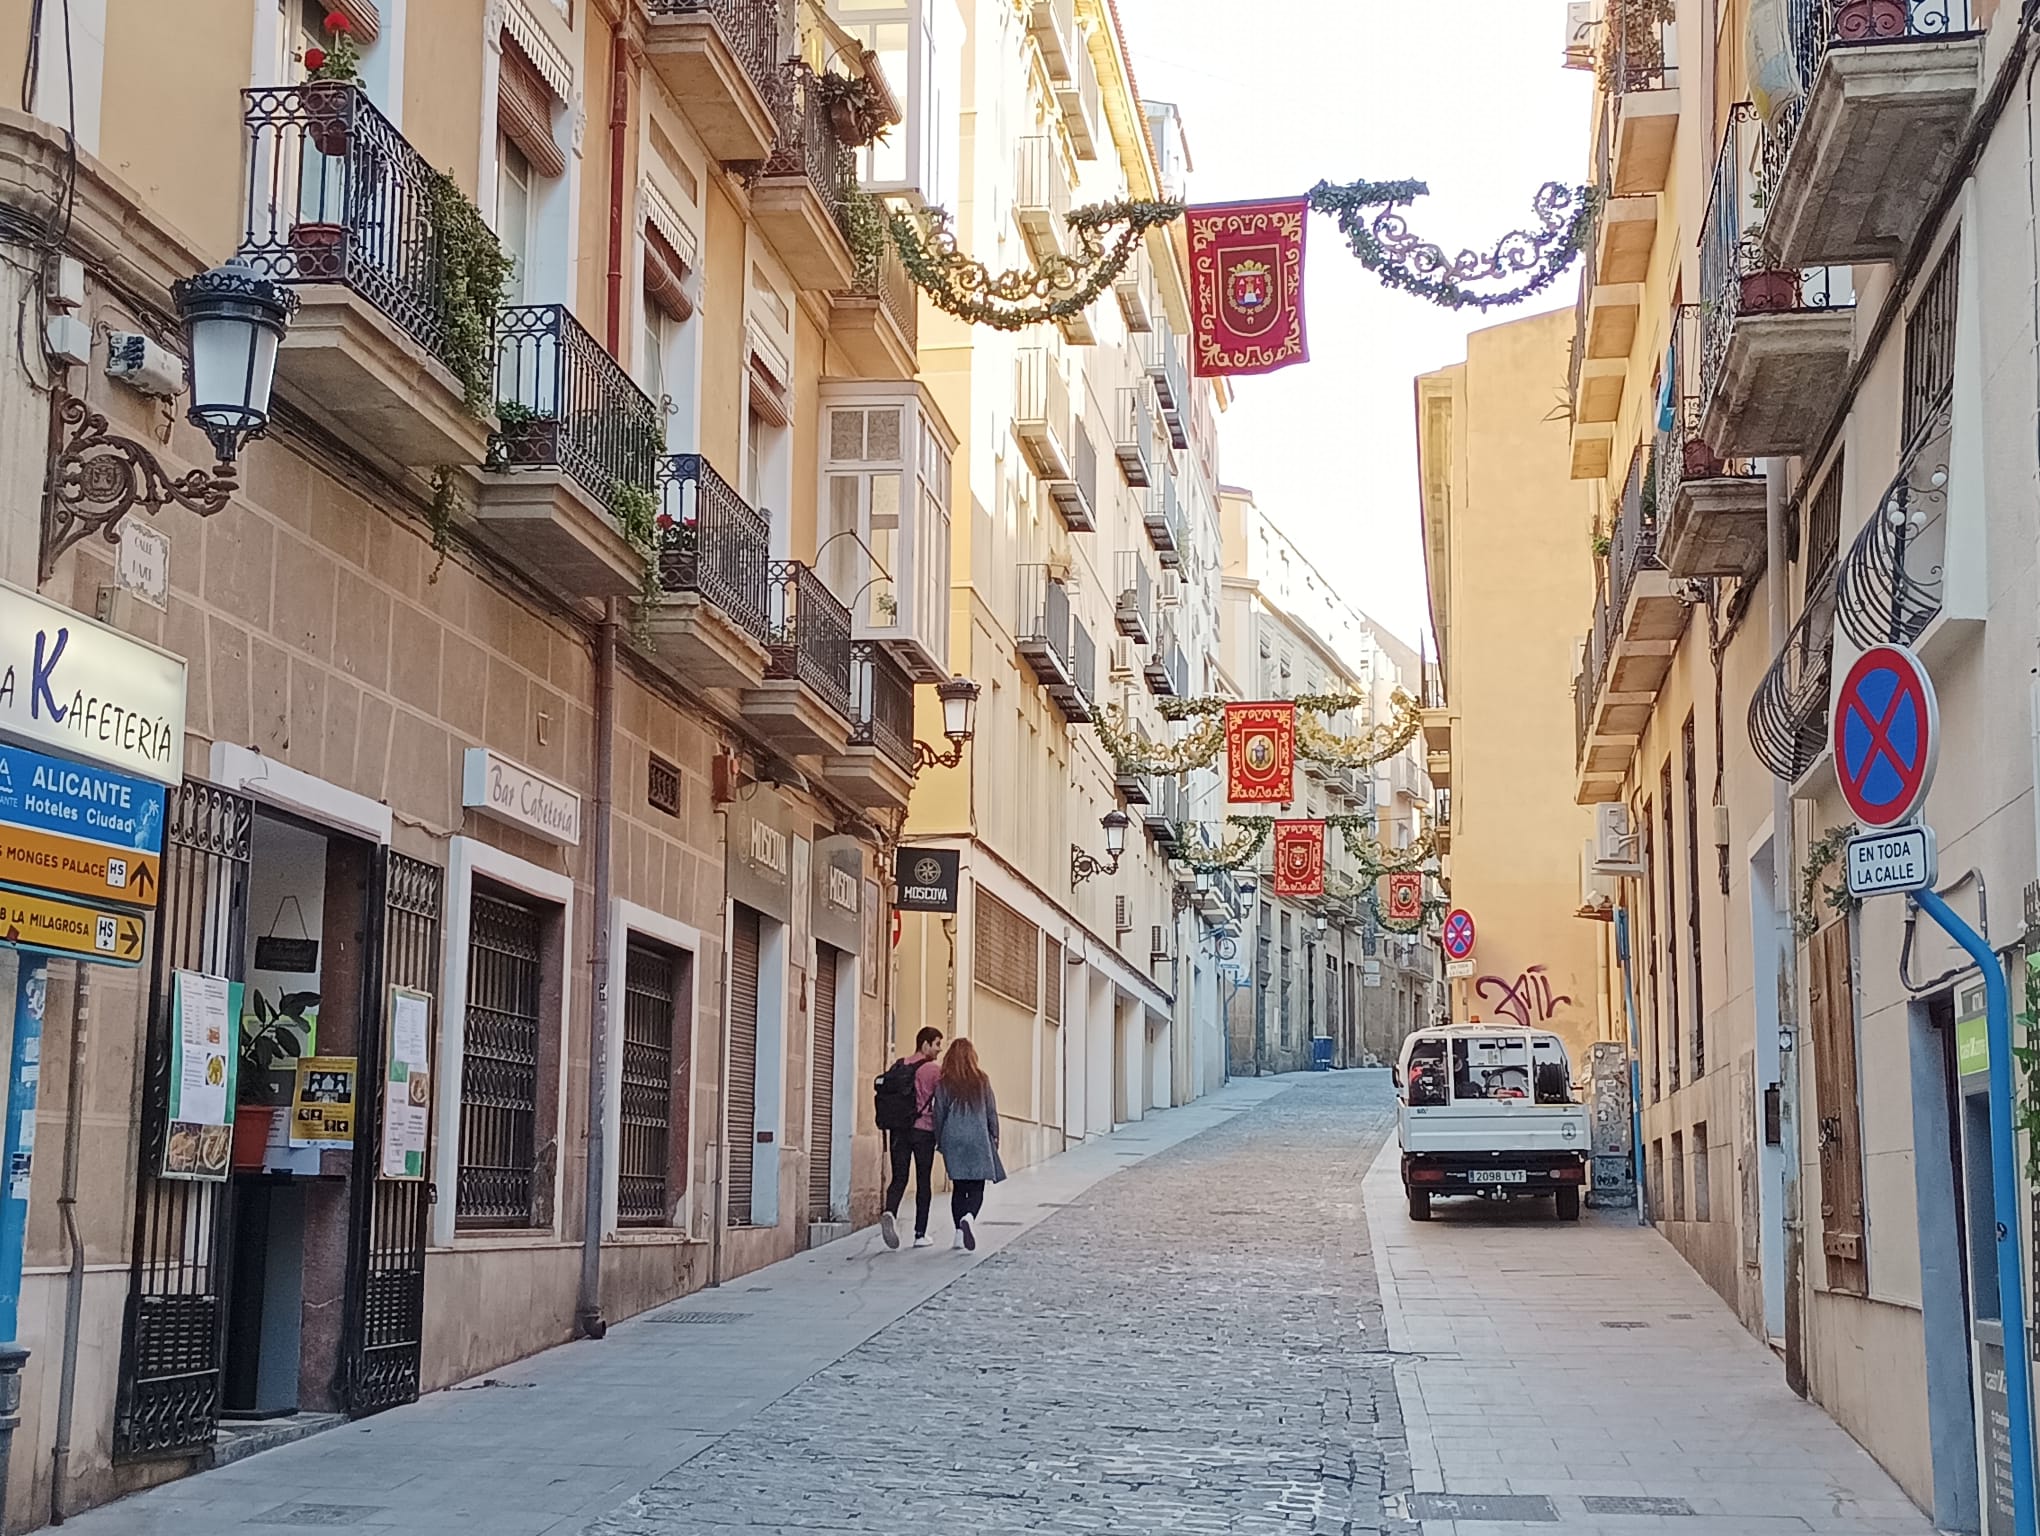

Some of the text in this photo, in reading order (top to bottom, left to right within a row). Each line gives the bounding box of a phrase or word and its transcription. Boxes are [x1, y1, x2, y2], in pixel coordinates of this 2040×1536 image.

[31, 627, 171, 763] KAFETERÍA
[32, 766, 132, 809] ALICANTE
[491, 765, 514, 807] Bar
[25, 794, 133, 833] Hoteles Ciudad
[7, 847, 58, 868] MONGES
[62, 858, 105, 878] PALACE
[110, 863, 124, 876] HS
[1859, 841, 1911, 862] EN TODA
[1857, 863, 1914, 885] LA CALLE
[904, 886, 948, 901] MOSCOVA
[12, 910, 24, 924] LA
[30, 913, 89, 936] MILAGROSA
[99, 920, 114, 938] HS
[1476, 1171, 1523, 1182] 2098 LYT
